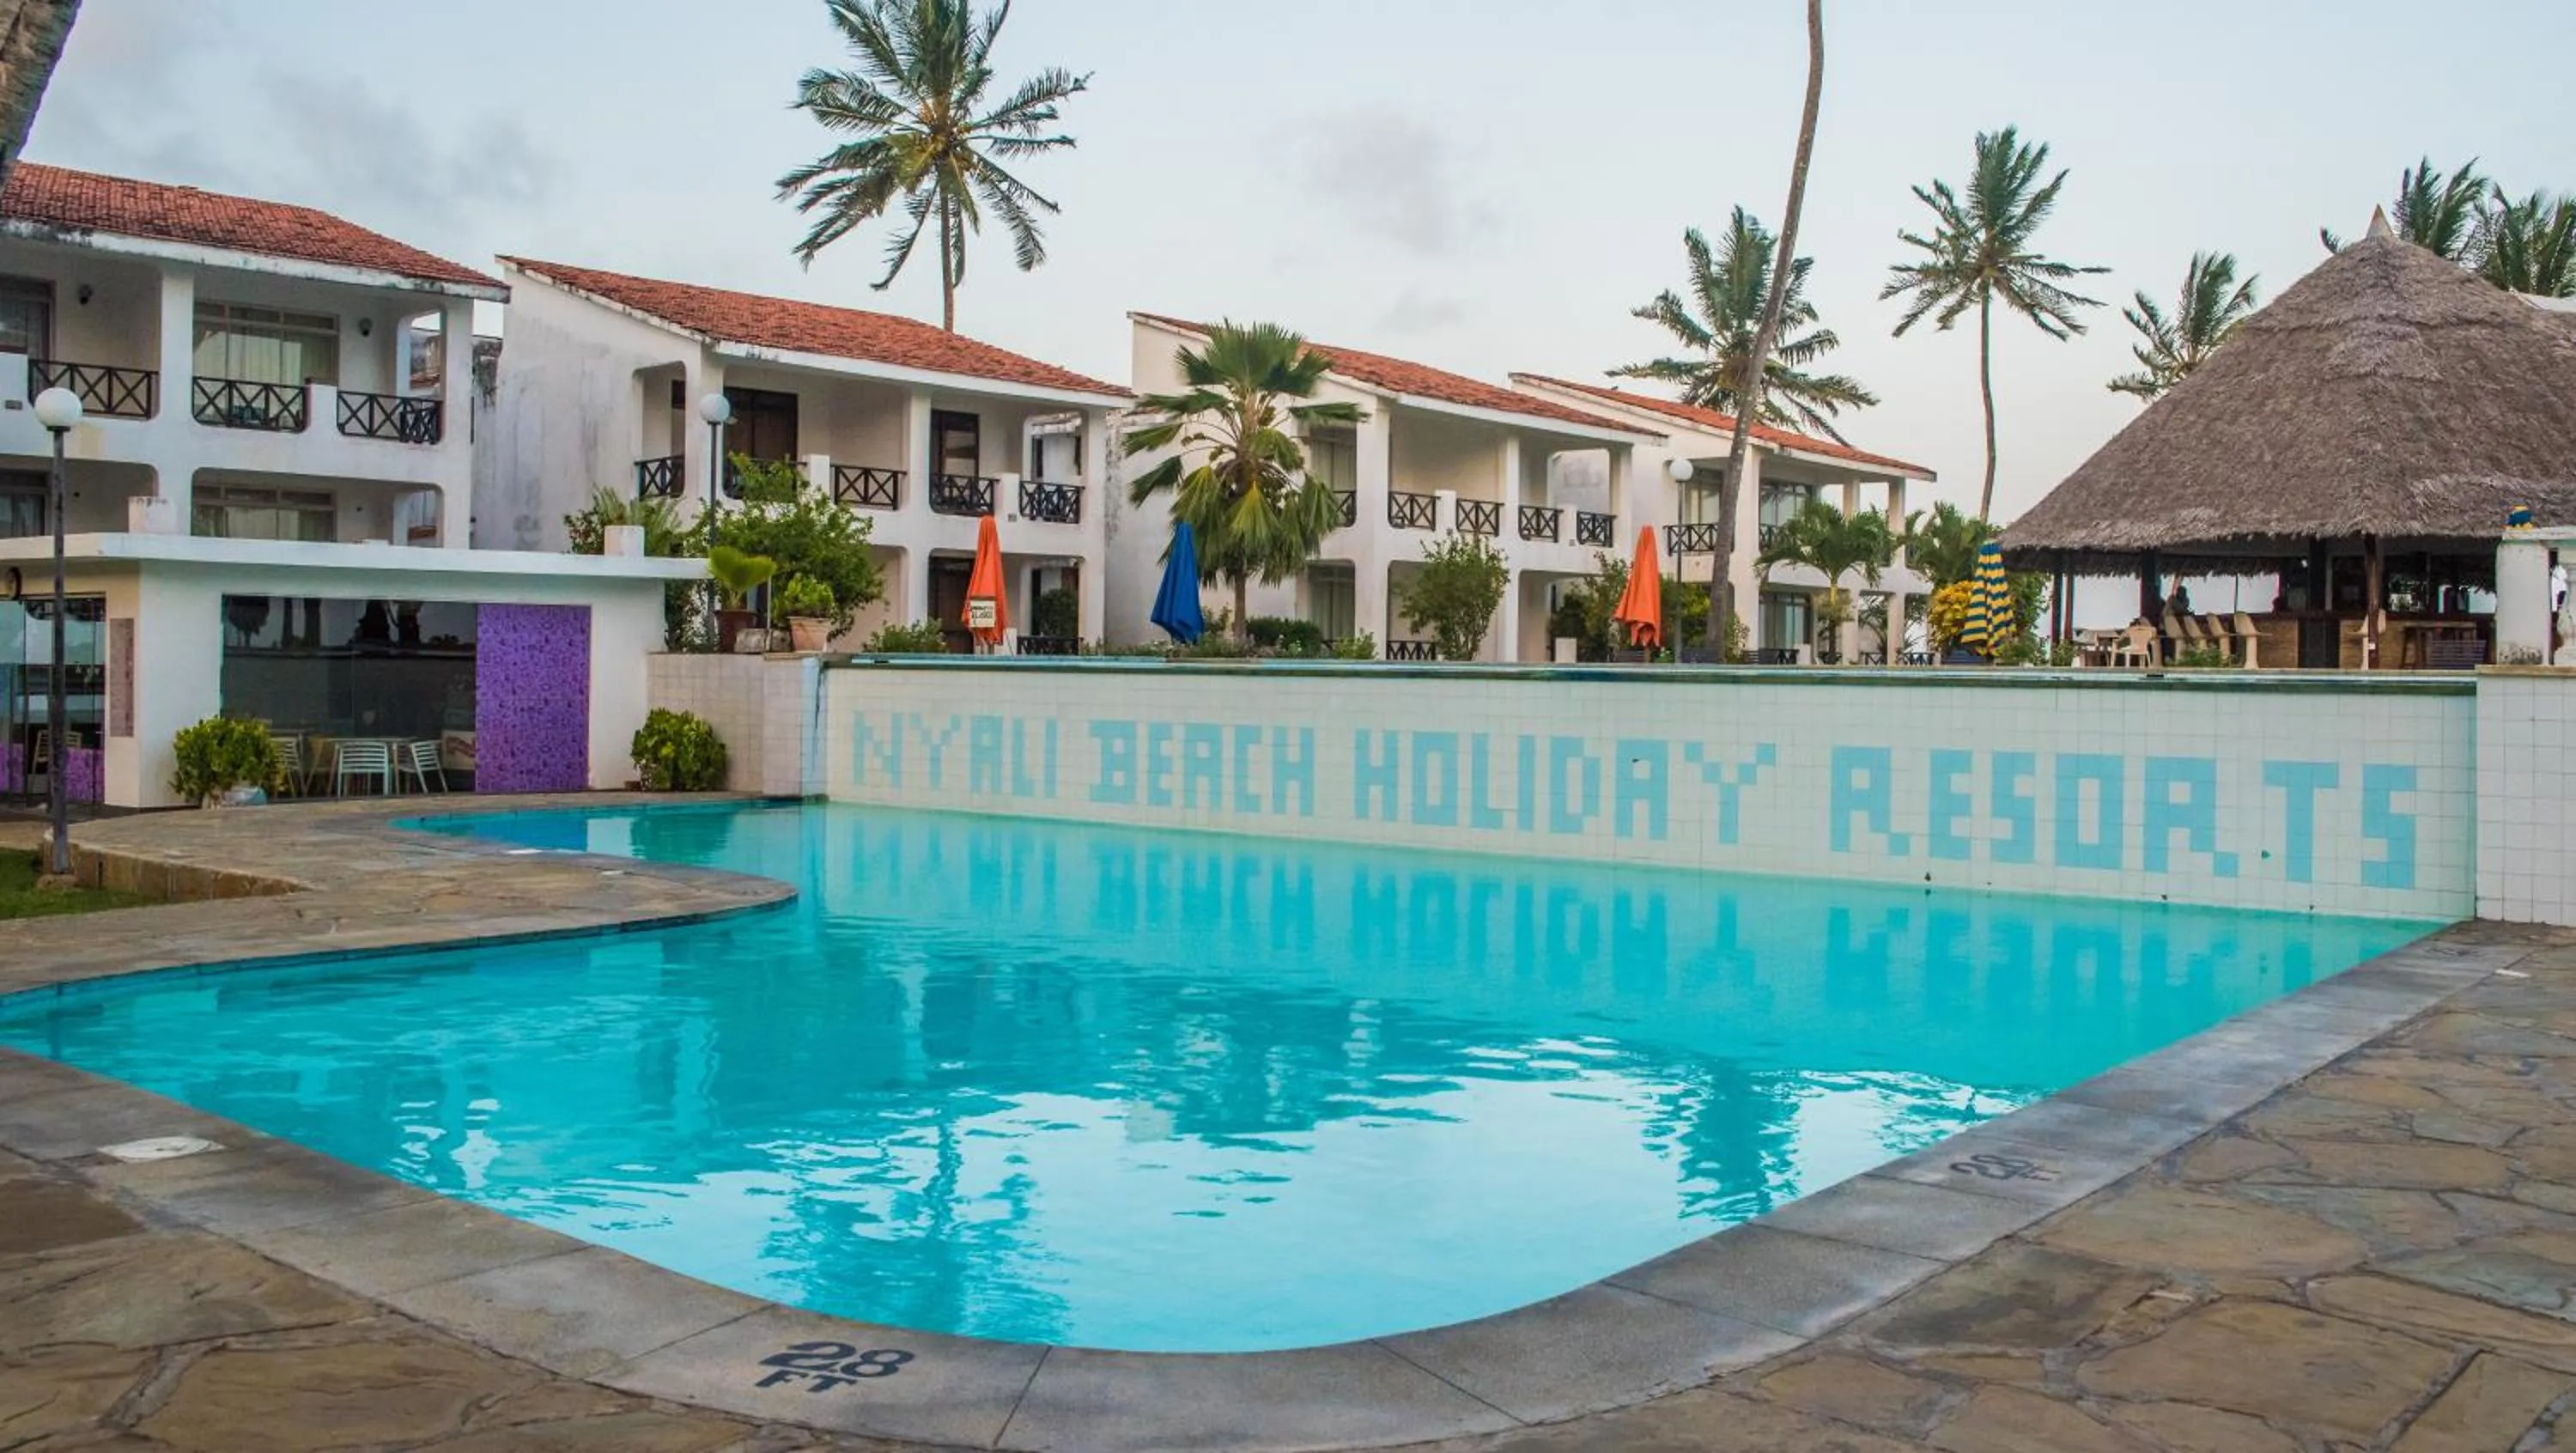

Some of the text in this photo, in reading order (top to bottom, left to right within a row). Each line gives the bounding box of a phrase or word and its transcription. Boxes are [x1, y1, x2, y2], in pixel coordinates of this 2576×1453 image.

[853, 710, 2416, 890] NYALI BEACH HOLIDAY RESORTS
[758, 1341, 916, 1378] 28
[755, 1369, 858, 1393] FT
